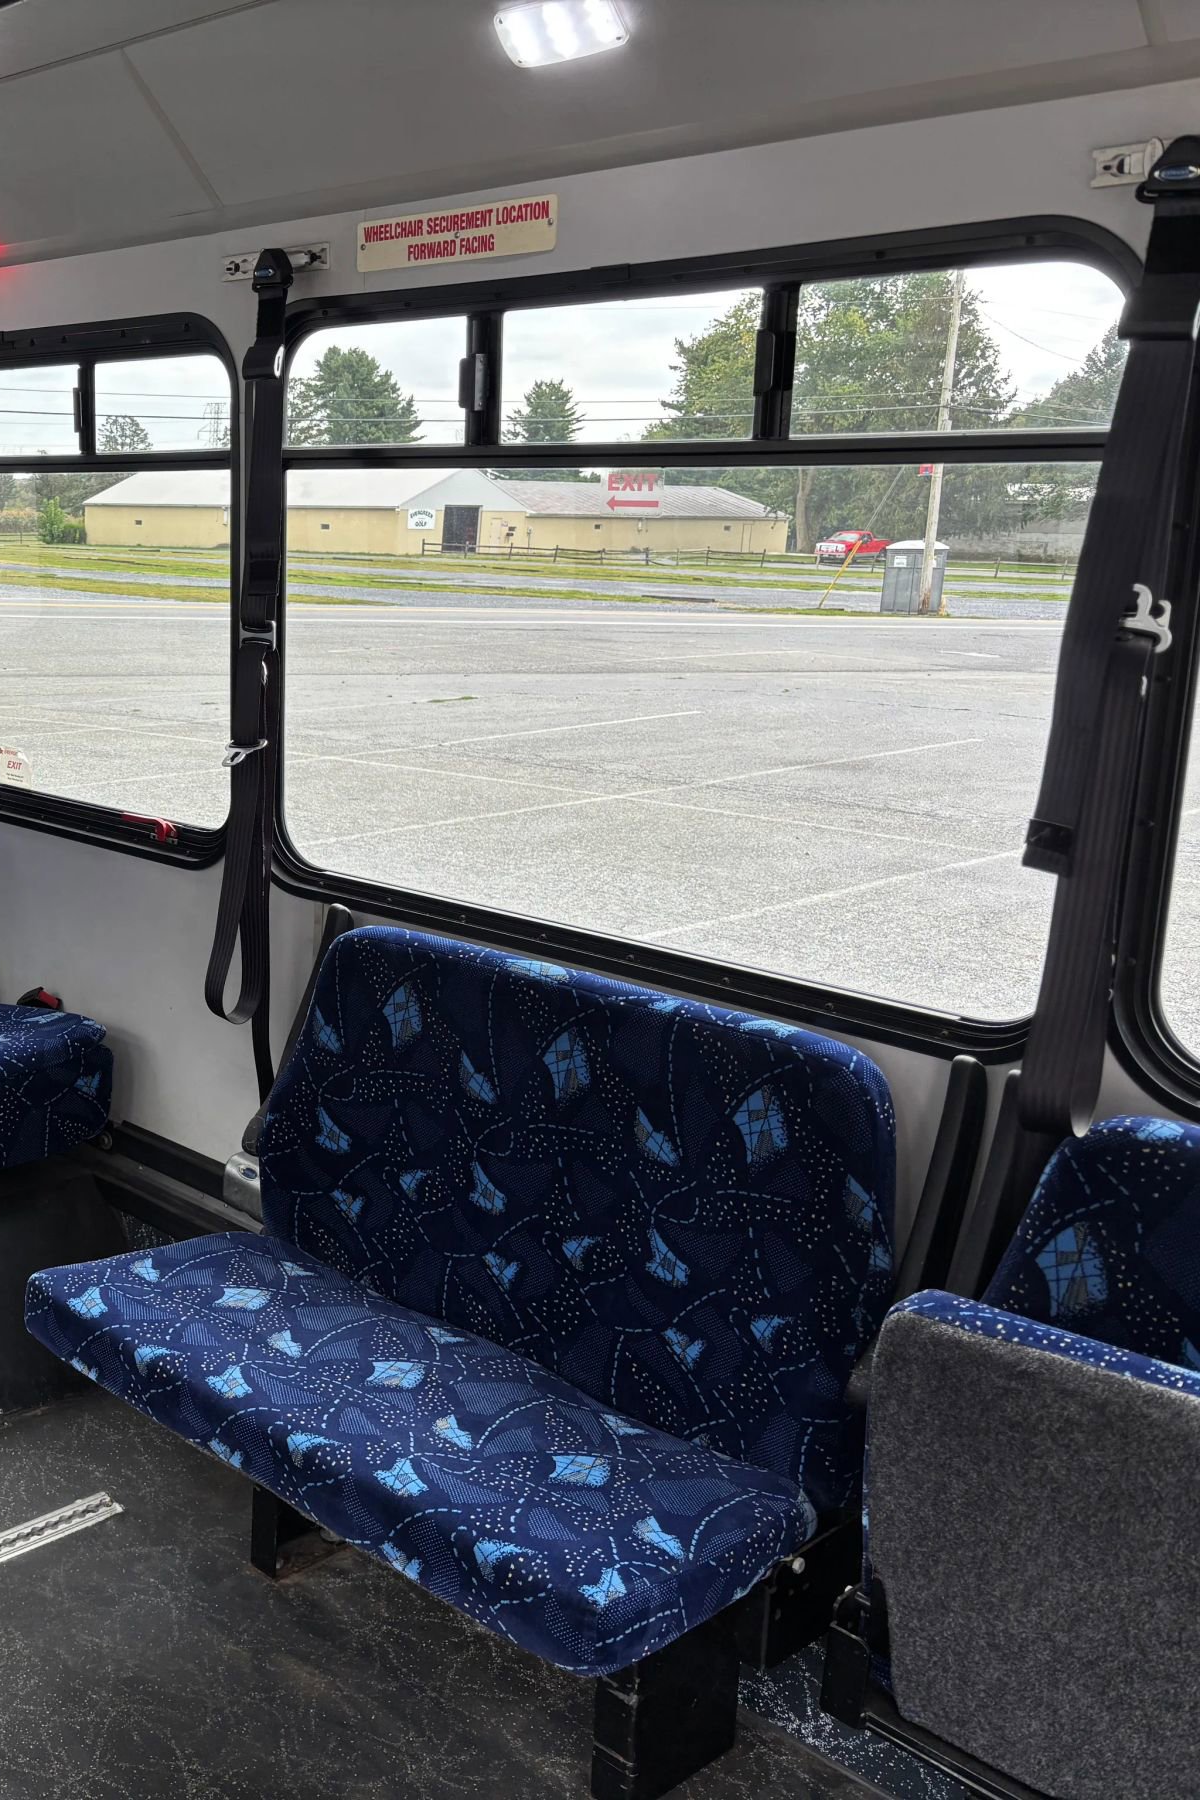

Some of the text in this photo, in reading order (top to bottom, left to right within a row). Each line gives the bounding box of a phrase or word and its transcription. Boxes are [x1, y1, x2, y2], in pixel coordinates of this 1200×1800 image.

[363, 200, 550, 244] WHEELCHAIR SECUREMENT LOCATION
[407, 233, 495, 262] FORWARD FACING
[607, 473, 657, 491] EXIT
[7, 761, 22, 770] EXIT
